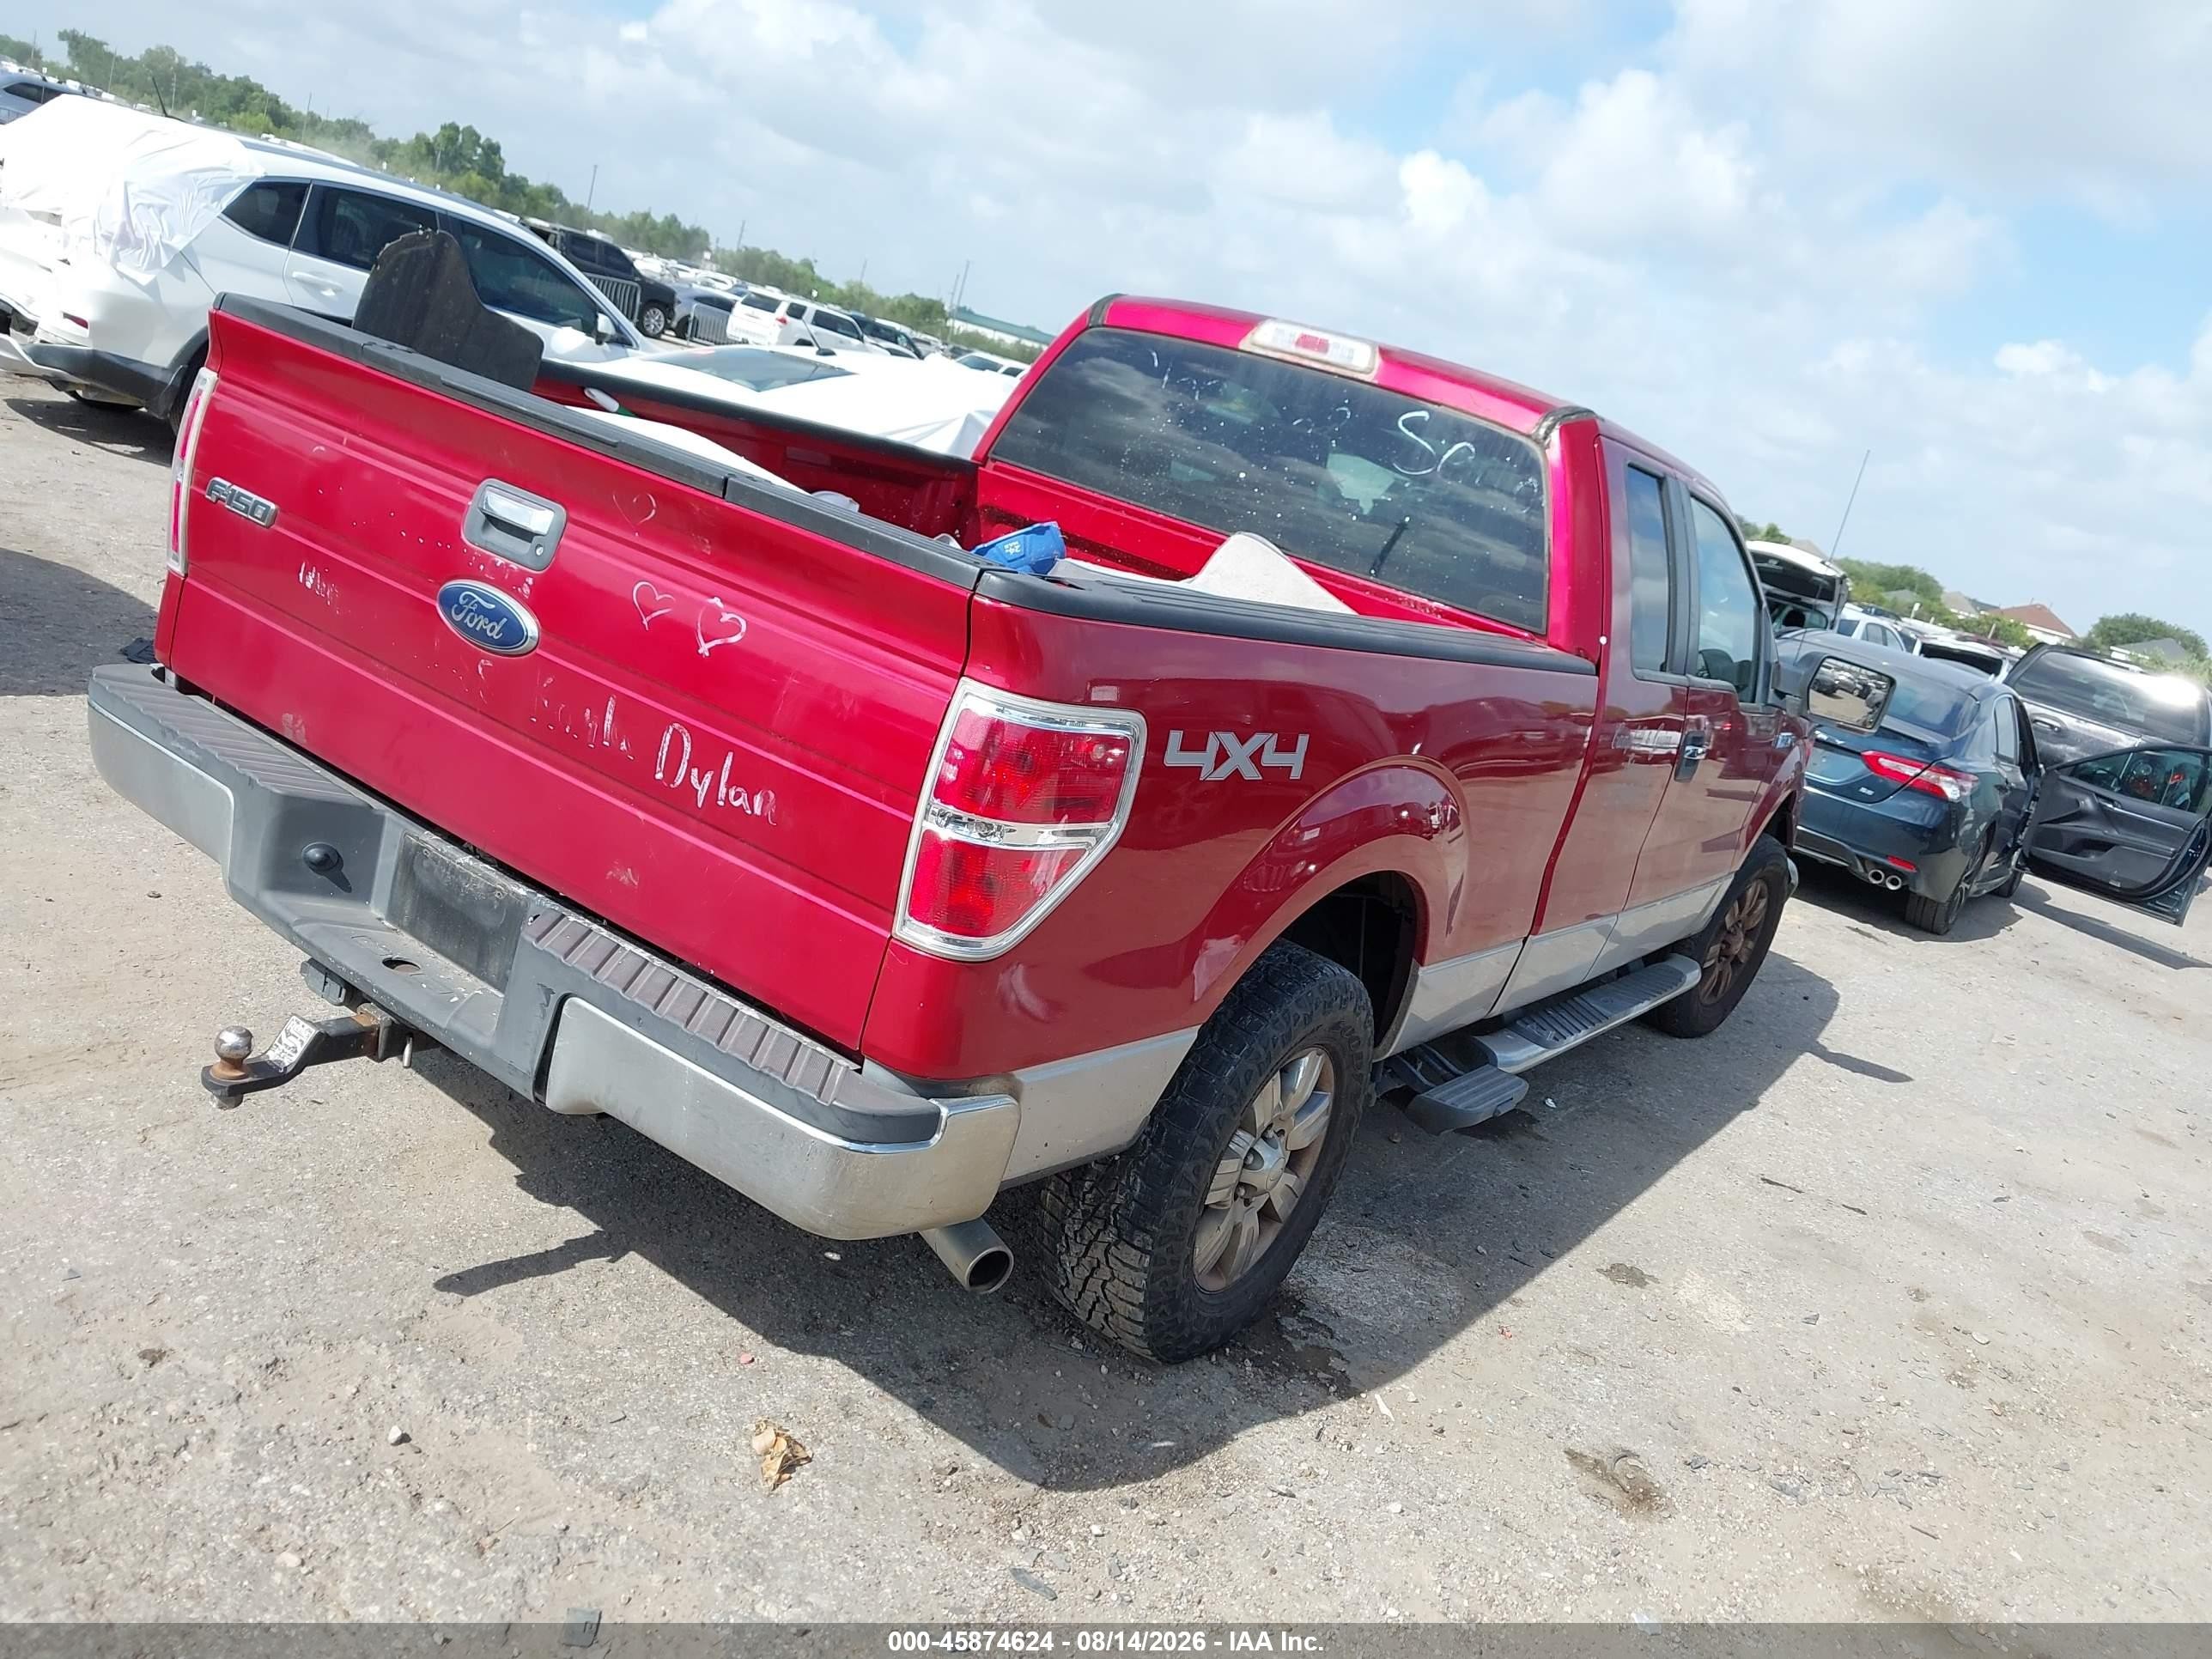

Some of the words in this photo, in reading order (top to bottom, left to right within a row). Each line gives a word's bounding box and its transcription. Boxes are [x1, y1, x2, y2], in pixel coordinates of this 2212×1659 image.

[206, 477, 279, 528] F-150
[451, 591, 508, 640] Ford
[654, 721, 778, 826] Dylan
